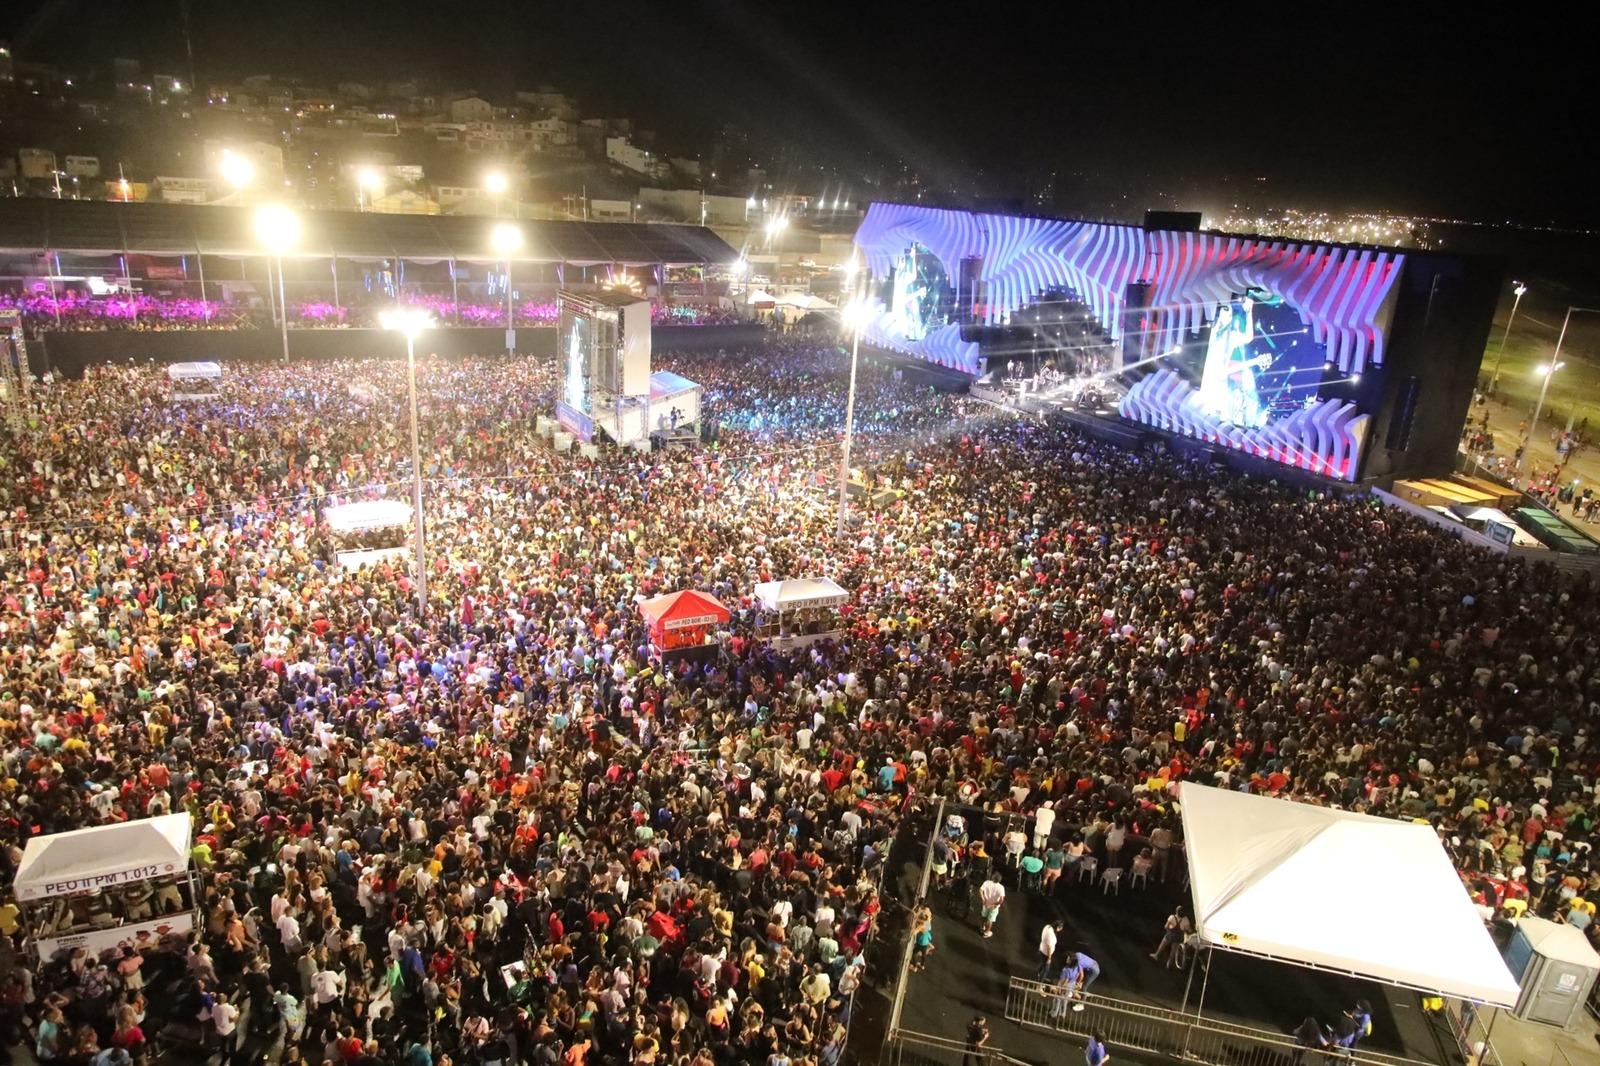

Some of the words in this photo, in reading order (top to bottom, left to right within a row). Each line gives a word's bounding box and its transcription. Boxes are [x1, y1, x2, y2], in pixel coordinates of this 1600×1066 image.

[45, 880, 78, 894] PEO
[82, 877, 90, 888] II
[95, 873, 117, 885] PM
[120, 865, 158, 880] 1.012
